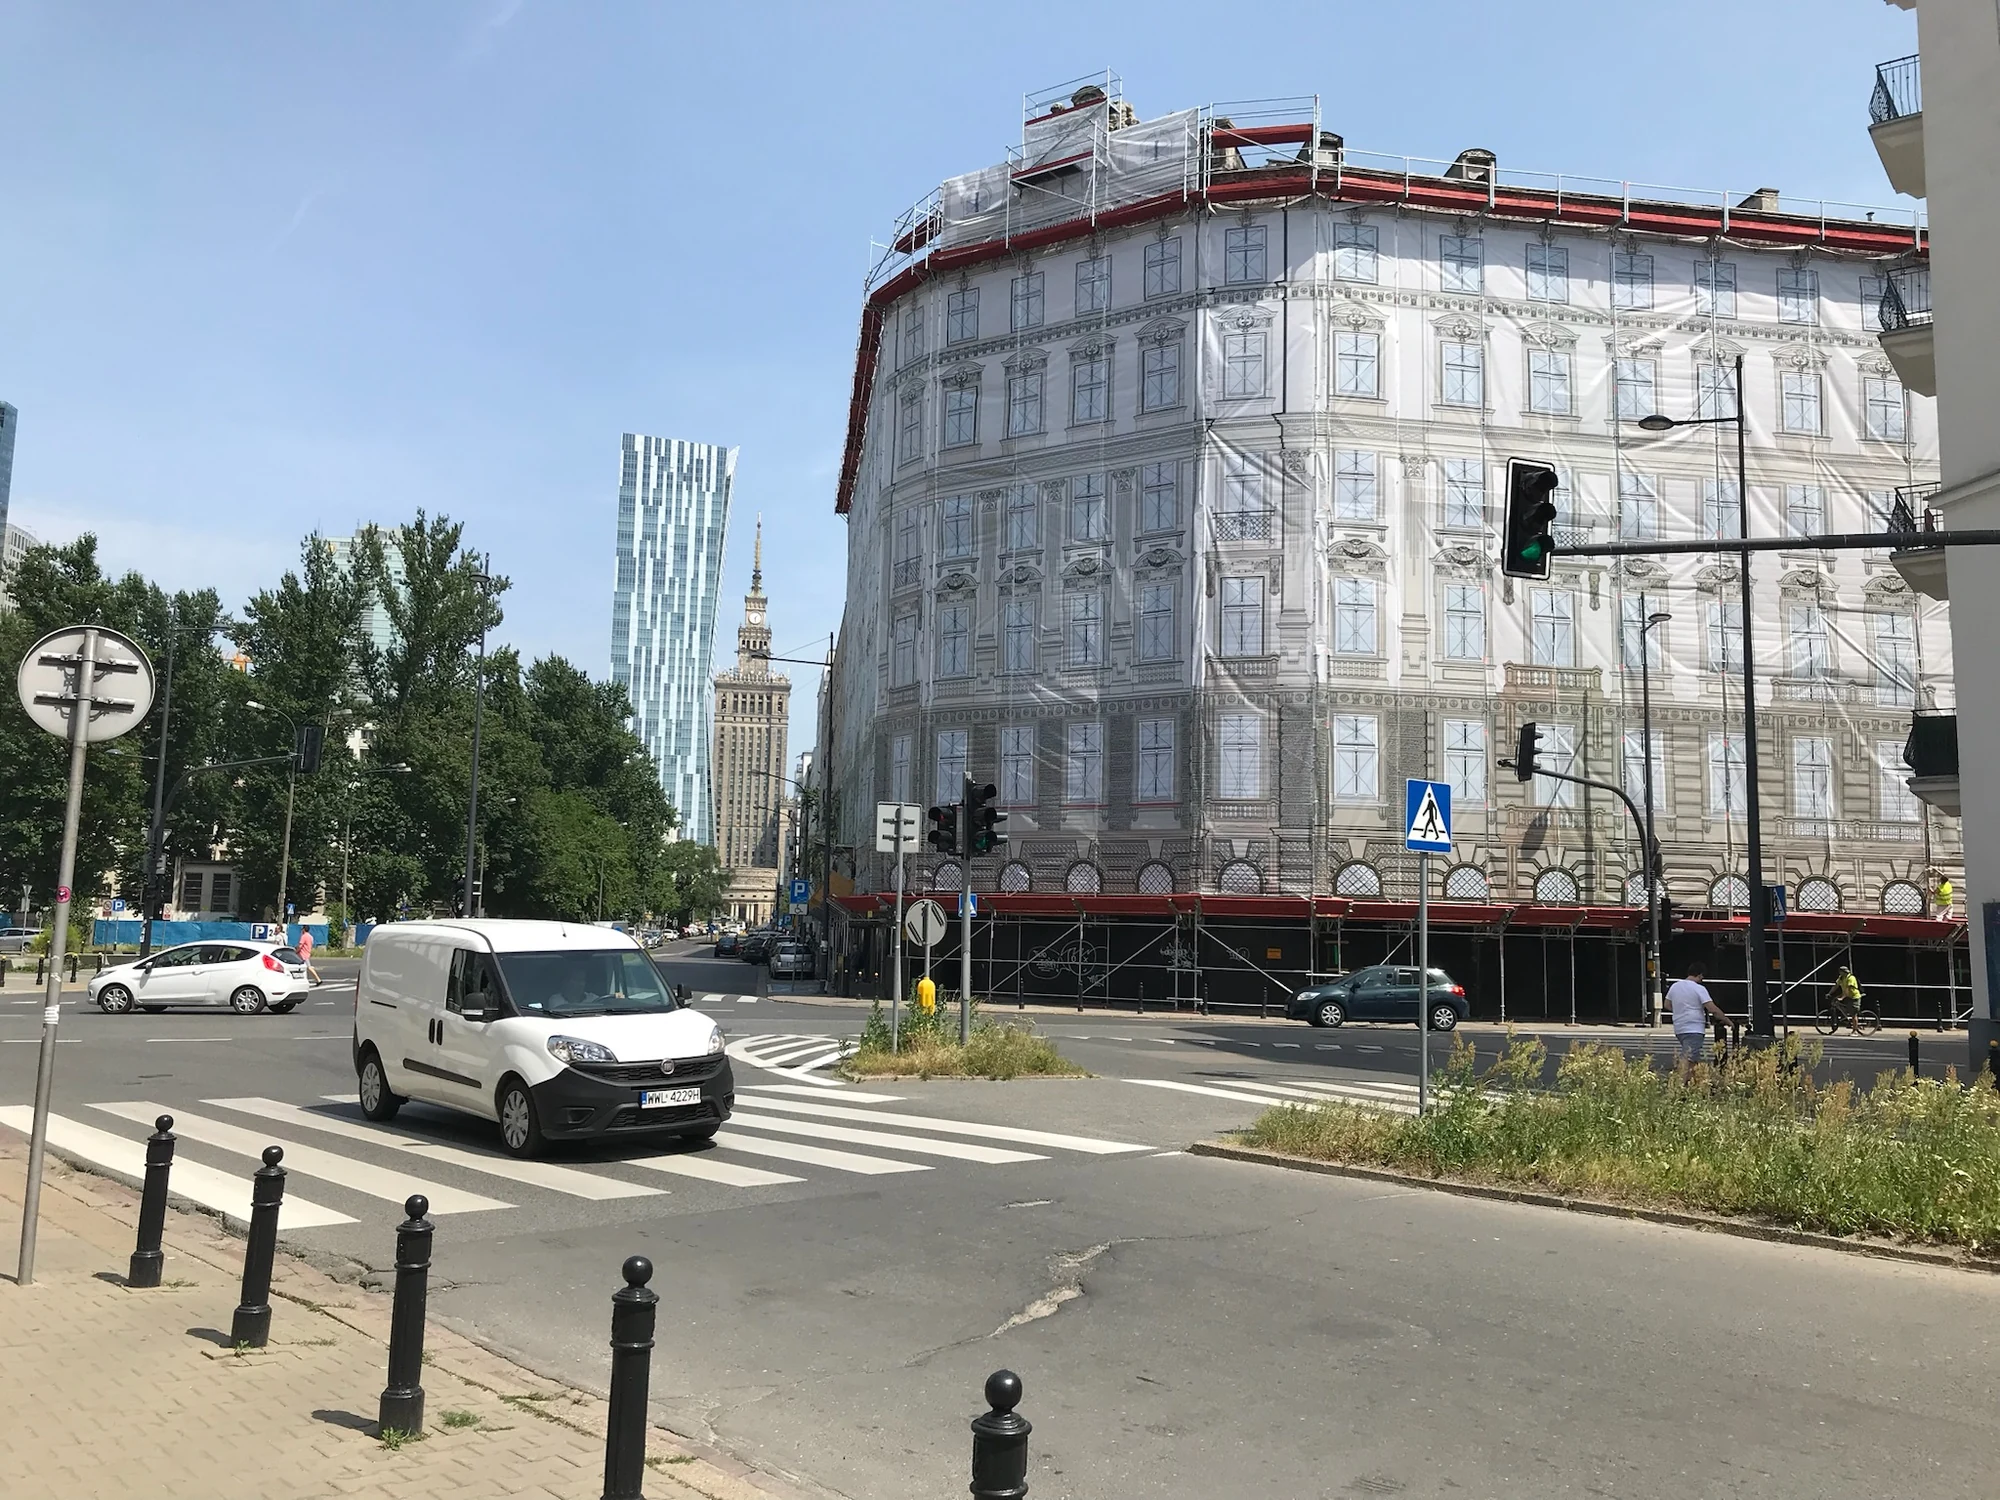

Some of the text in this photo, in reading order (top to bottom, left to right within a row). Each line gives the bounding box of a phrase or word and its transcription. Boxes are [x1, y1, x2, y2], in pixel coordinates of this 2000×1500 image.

[794, 882, 805, 897] P
[114, 901, 122, 910] P
[255, 925, 265, 938] P
[647, 1089, 699, 1104] WWL 4229H
